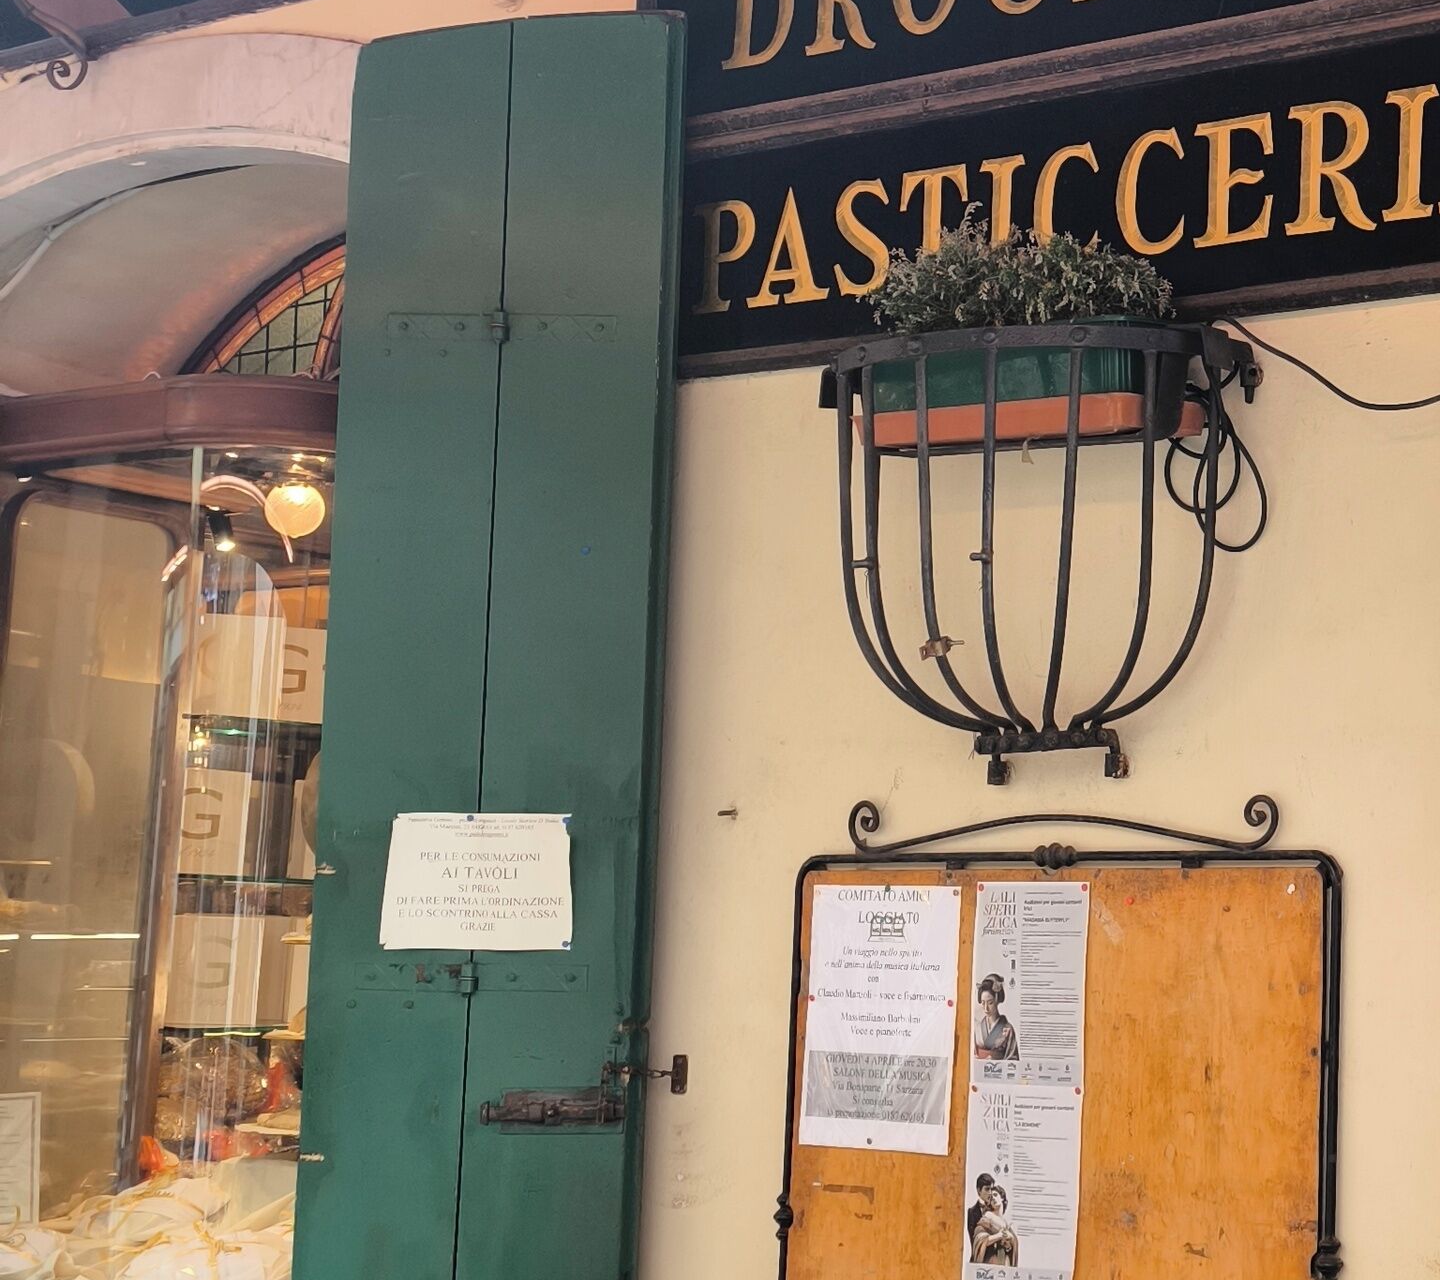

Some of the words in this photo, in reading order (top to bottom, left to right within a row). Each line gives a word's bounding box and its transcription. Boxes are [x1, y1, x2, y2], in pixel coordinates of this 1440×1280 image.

[420, 851, 441, 861] PER
[461, 852, 541, 862] CONSUMAZIONI
[441, 866, 458, 879] AI
[465, 866, 518, 880] TAVOLI
[458, 884, 468, 893] SI
[471, 884, 501, 893] PREGA
[411, 896, 441, 905] FARE
[443, 896, 479, 905] PRIMA
[838, 889, 897, 902] COMITATO
[426, 909, 489, 918] SCONTRINO
[490, 910, 518, 919] ALLA
[520, 909, 559, 919] CASSA
[858, 910, 920, 925] LOGGIATO
[460, 921, 496, 931] GRAZIE
